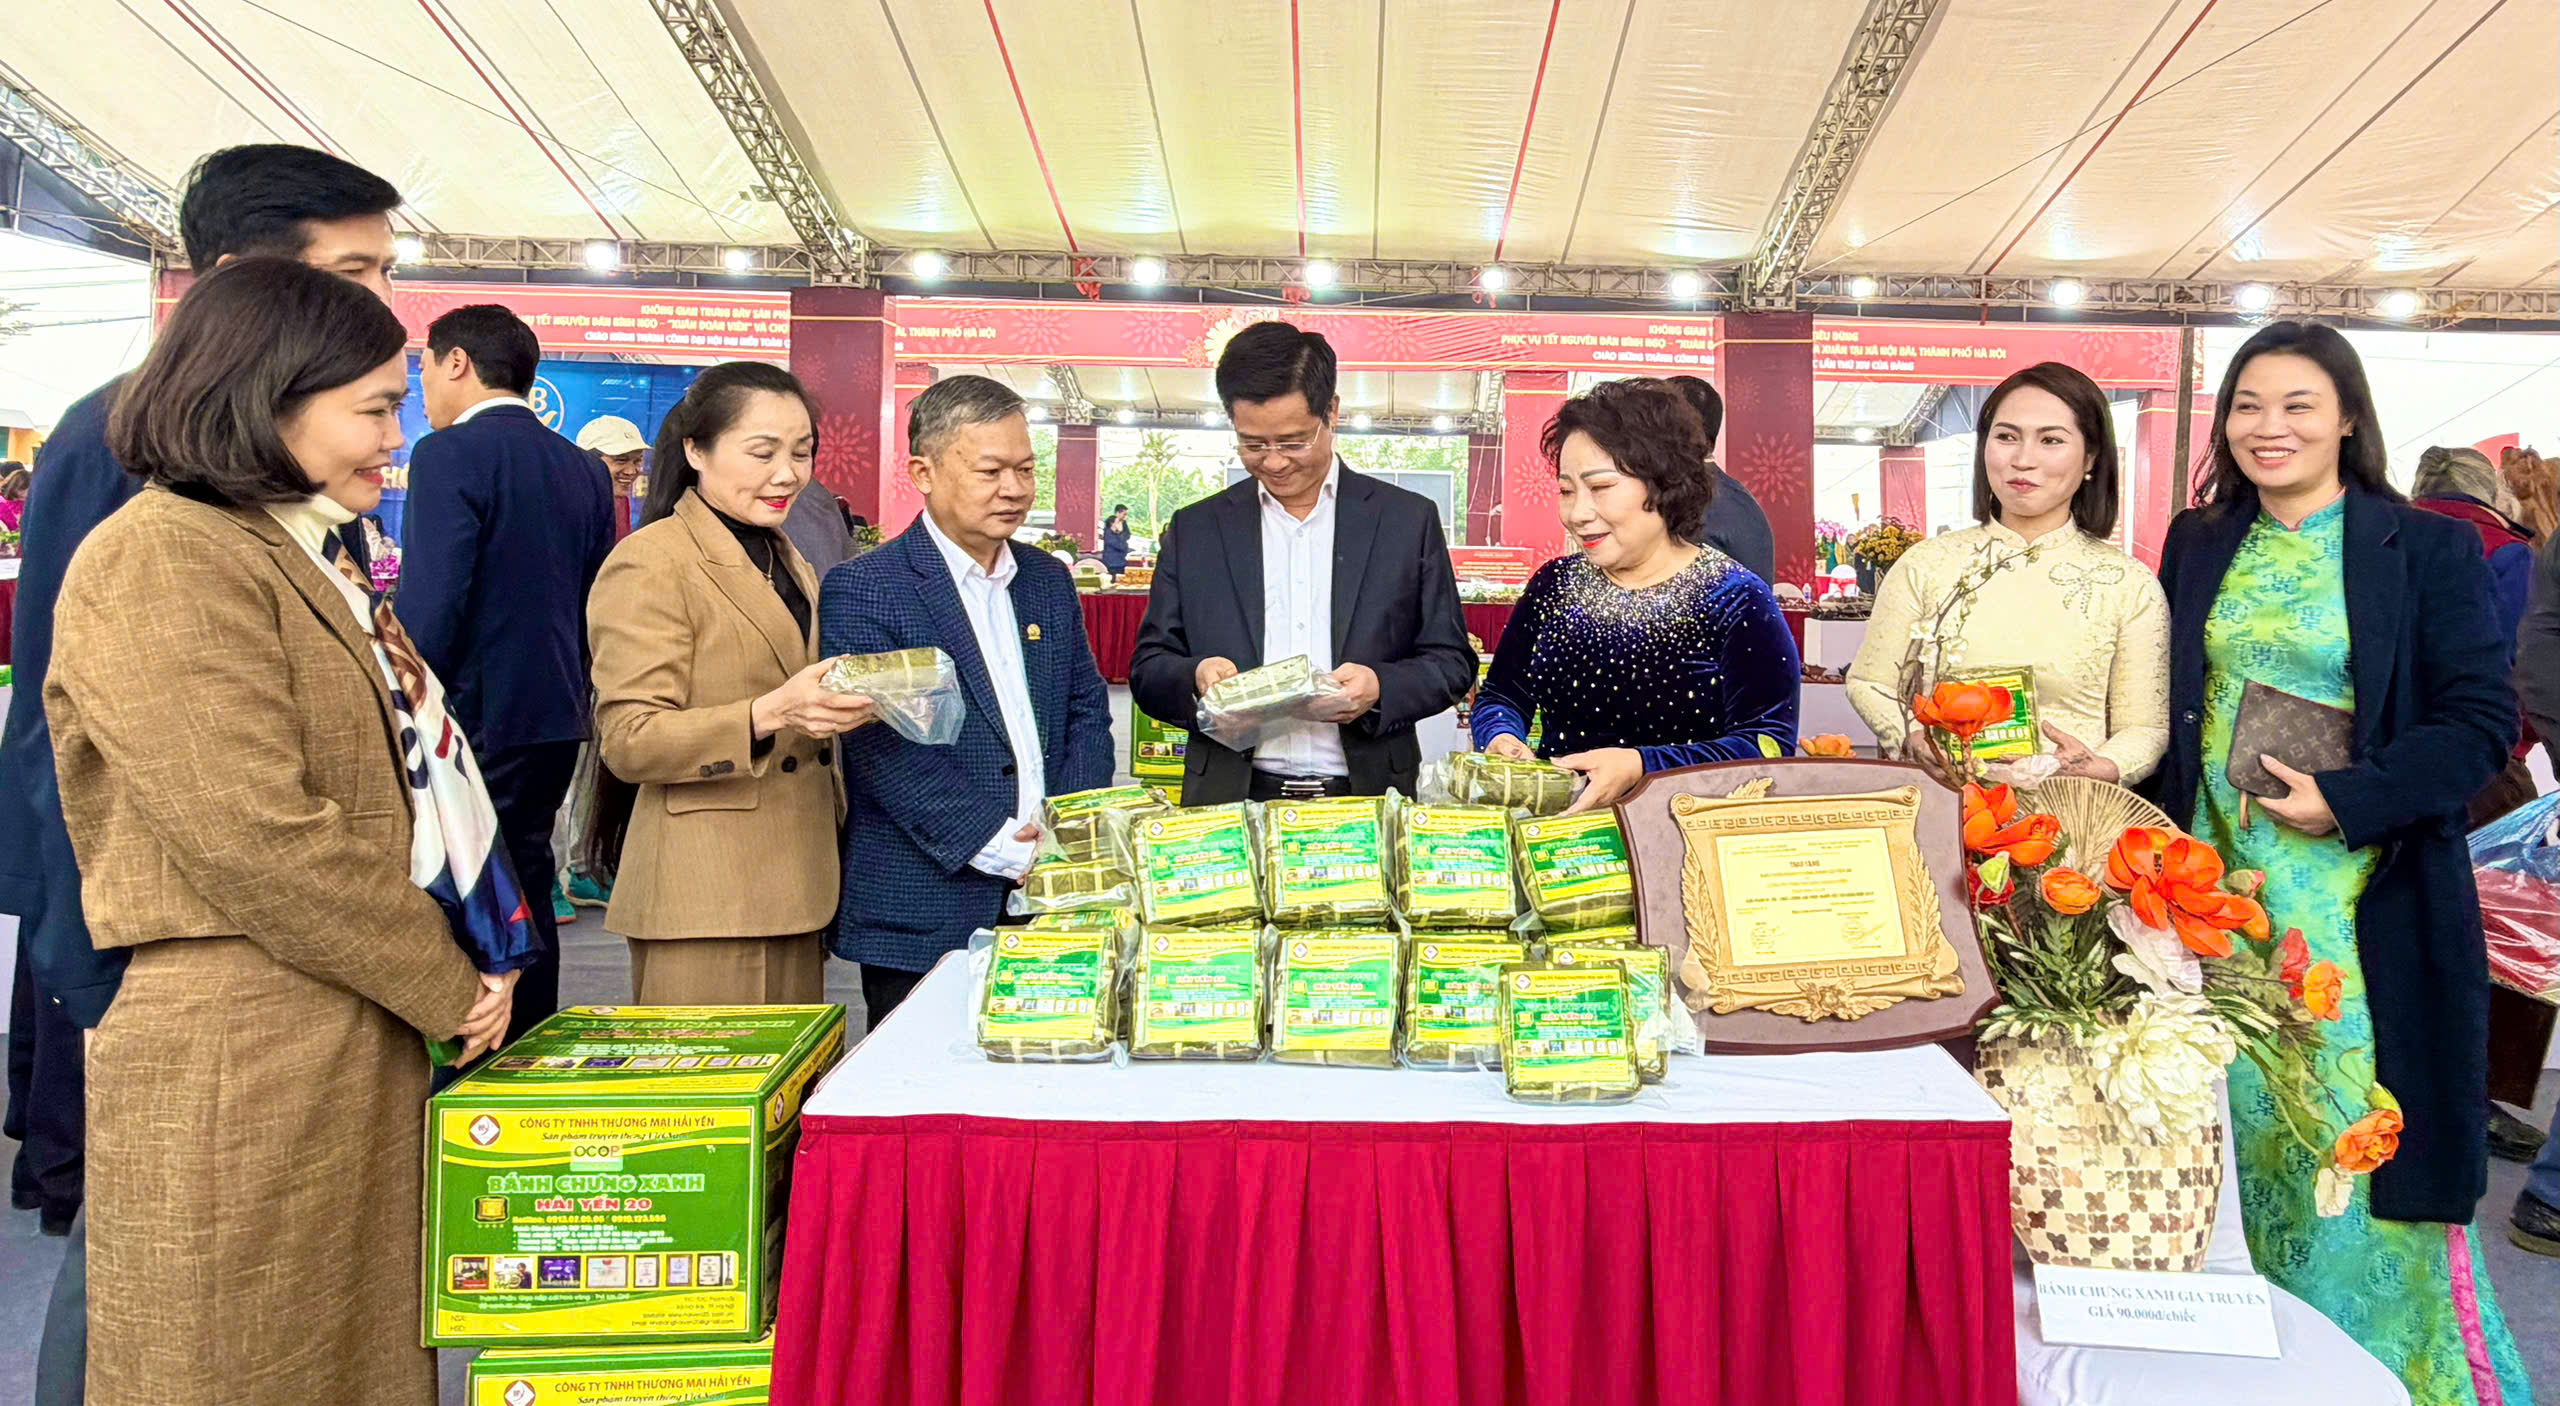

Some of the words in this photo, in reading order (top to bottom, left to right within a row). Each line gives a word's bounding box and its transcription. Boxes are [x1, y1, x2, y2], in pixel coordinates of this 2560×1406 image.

[519, 1117, 551, 1129] CÔNG
[553, 1118, 566, 1128] TY
[569, 1118, 599, 1129] TNHH
[601, 1117, 647, 1128] THƯƠNG
[650, 1117, 671, 1130] MẠI
[673, 1114, 692, 1127] HẢI
[694, 1115, 715, 1127] YẾN
[574, 1145, 621, 1158] OCOP
[487, 1172, 553, 1194] BÁNH
[555, 1173, 637, 1193] CHƯNG
[638, 1173, 705, 1193] XANH
[535, 1195, 574, 1212] HẢI
[577, 1193, 620, 1212] YẾN
[624, 1197, 652, 1211] 20
[2039, 1280, 2077, 1297] BÁNH
[2135, 1287, 2174, 1301] XANH
[2177, 1290, 2205, 1302] GIA
[2088, 1303, 2114, 1319] GIÁ
[554, 1382, 586, 1393] CÔNG
[588, 1381, 601, 1391] TY
[604, 1380, 634, 1391] TNHH
[637, 1378, 684, 1389] THƯƠNG
[686, 1377, 707, 1390] MẠI
[709, 1374, 728, 1386] HẢI
[730, 1375, 751, 1386] YẾN
